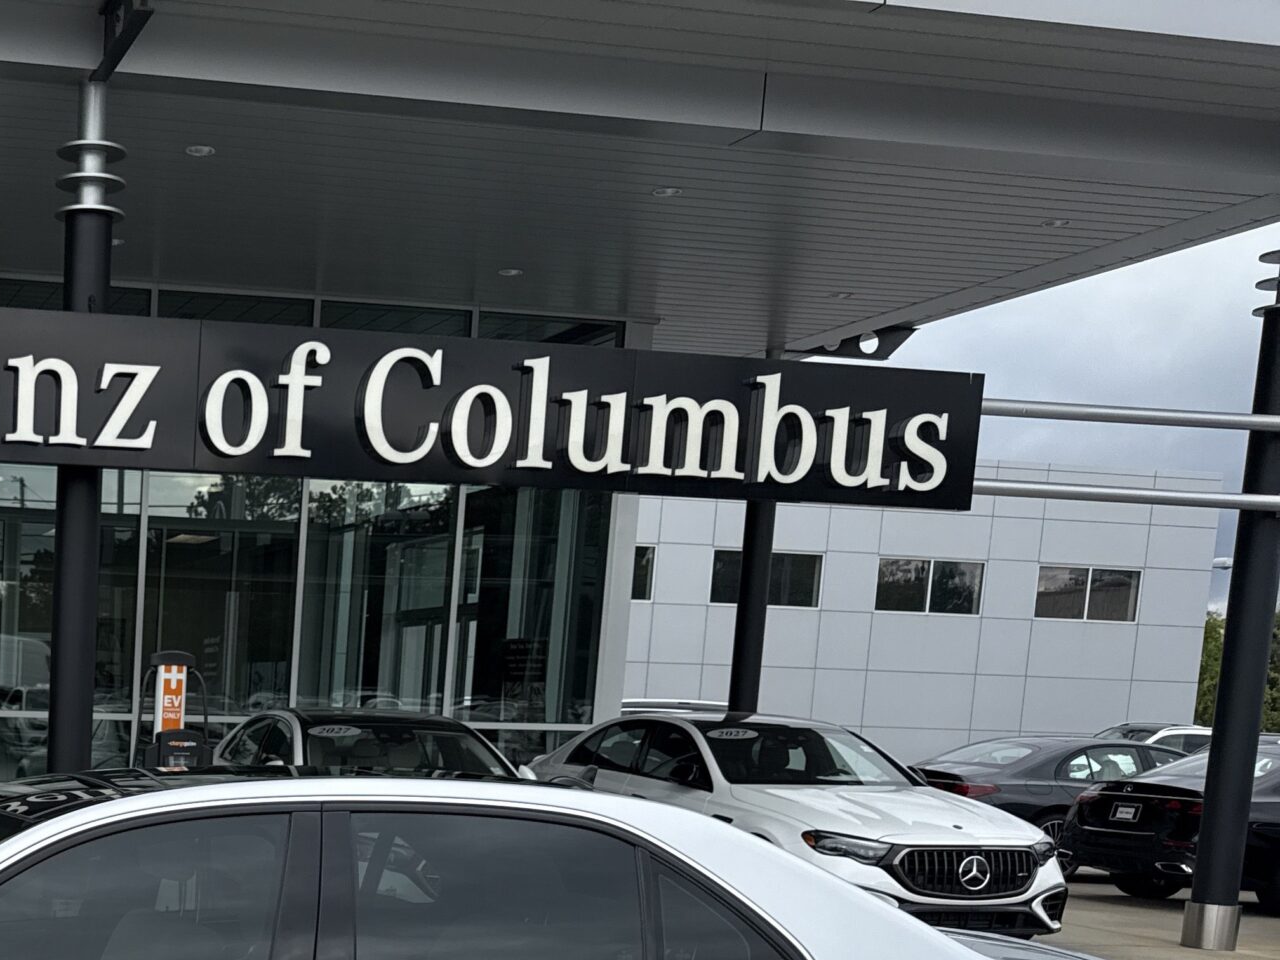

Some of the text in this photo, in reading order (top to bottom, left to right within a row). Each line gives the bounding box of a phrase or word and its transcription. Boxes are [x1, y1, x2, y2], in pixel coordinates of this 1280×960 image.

[205, 341, 332, 458] of
[364, 347, 950, 492] Columbus
[164, 694, 181, 707] EV
[163, 712, 181, 720] ONLY
[317, 727, 352, 735] 2027
